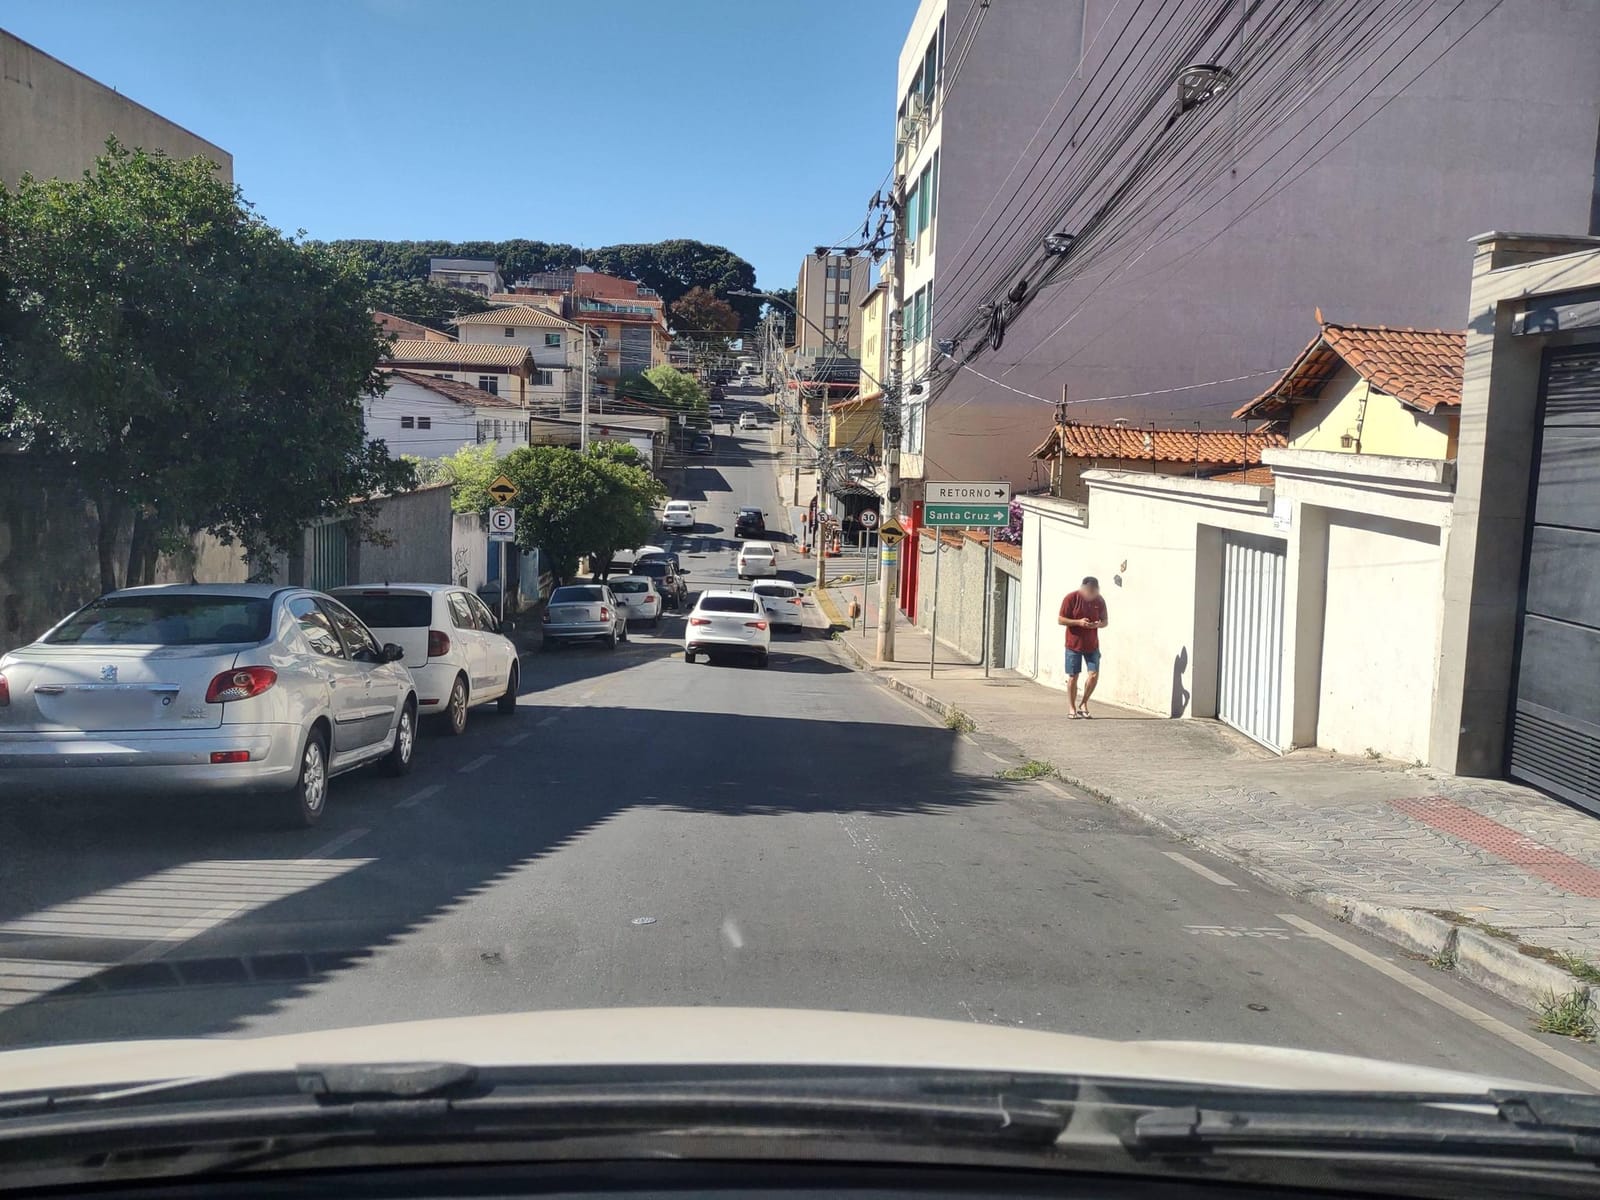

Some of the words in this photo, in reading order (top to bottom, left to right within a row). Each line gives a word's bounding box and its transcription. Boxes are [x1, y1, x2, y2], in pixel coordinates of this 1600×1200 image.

[939, 488, 991, 498] RETORNO
[863, 513, 875, 522] 30
[929, 511, 960, 520] Santa
[963, 511, 990, 520] Cruz
[498, 515, 506, 526] E
